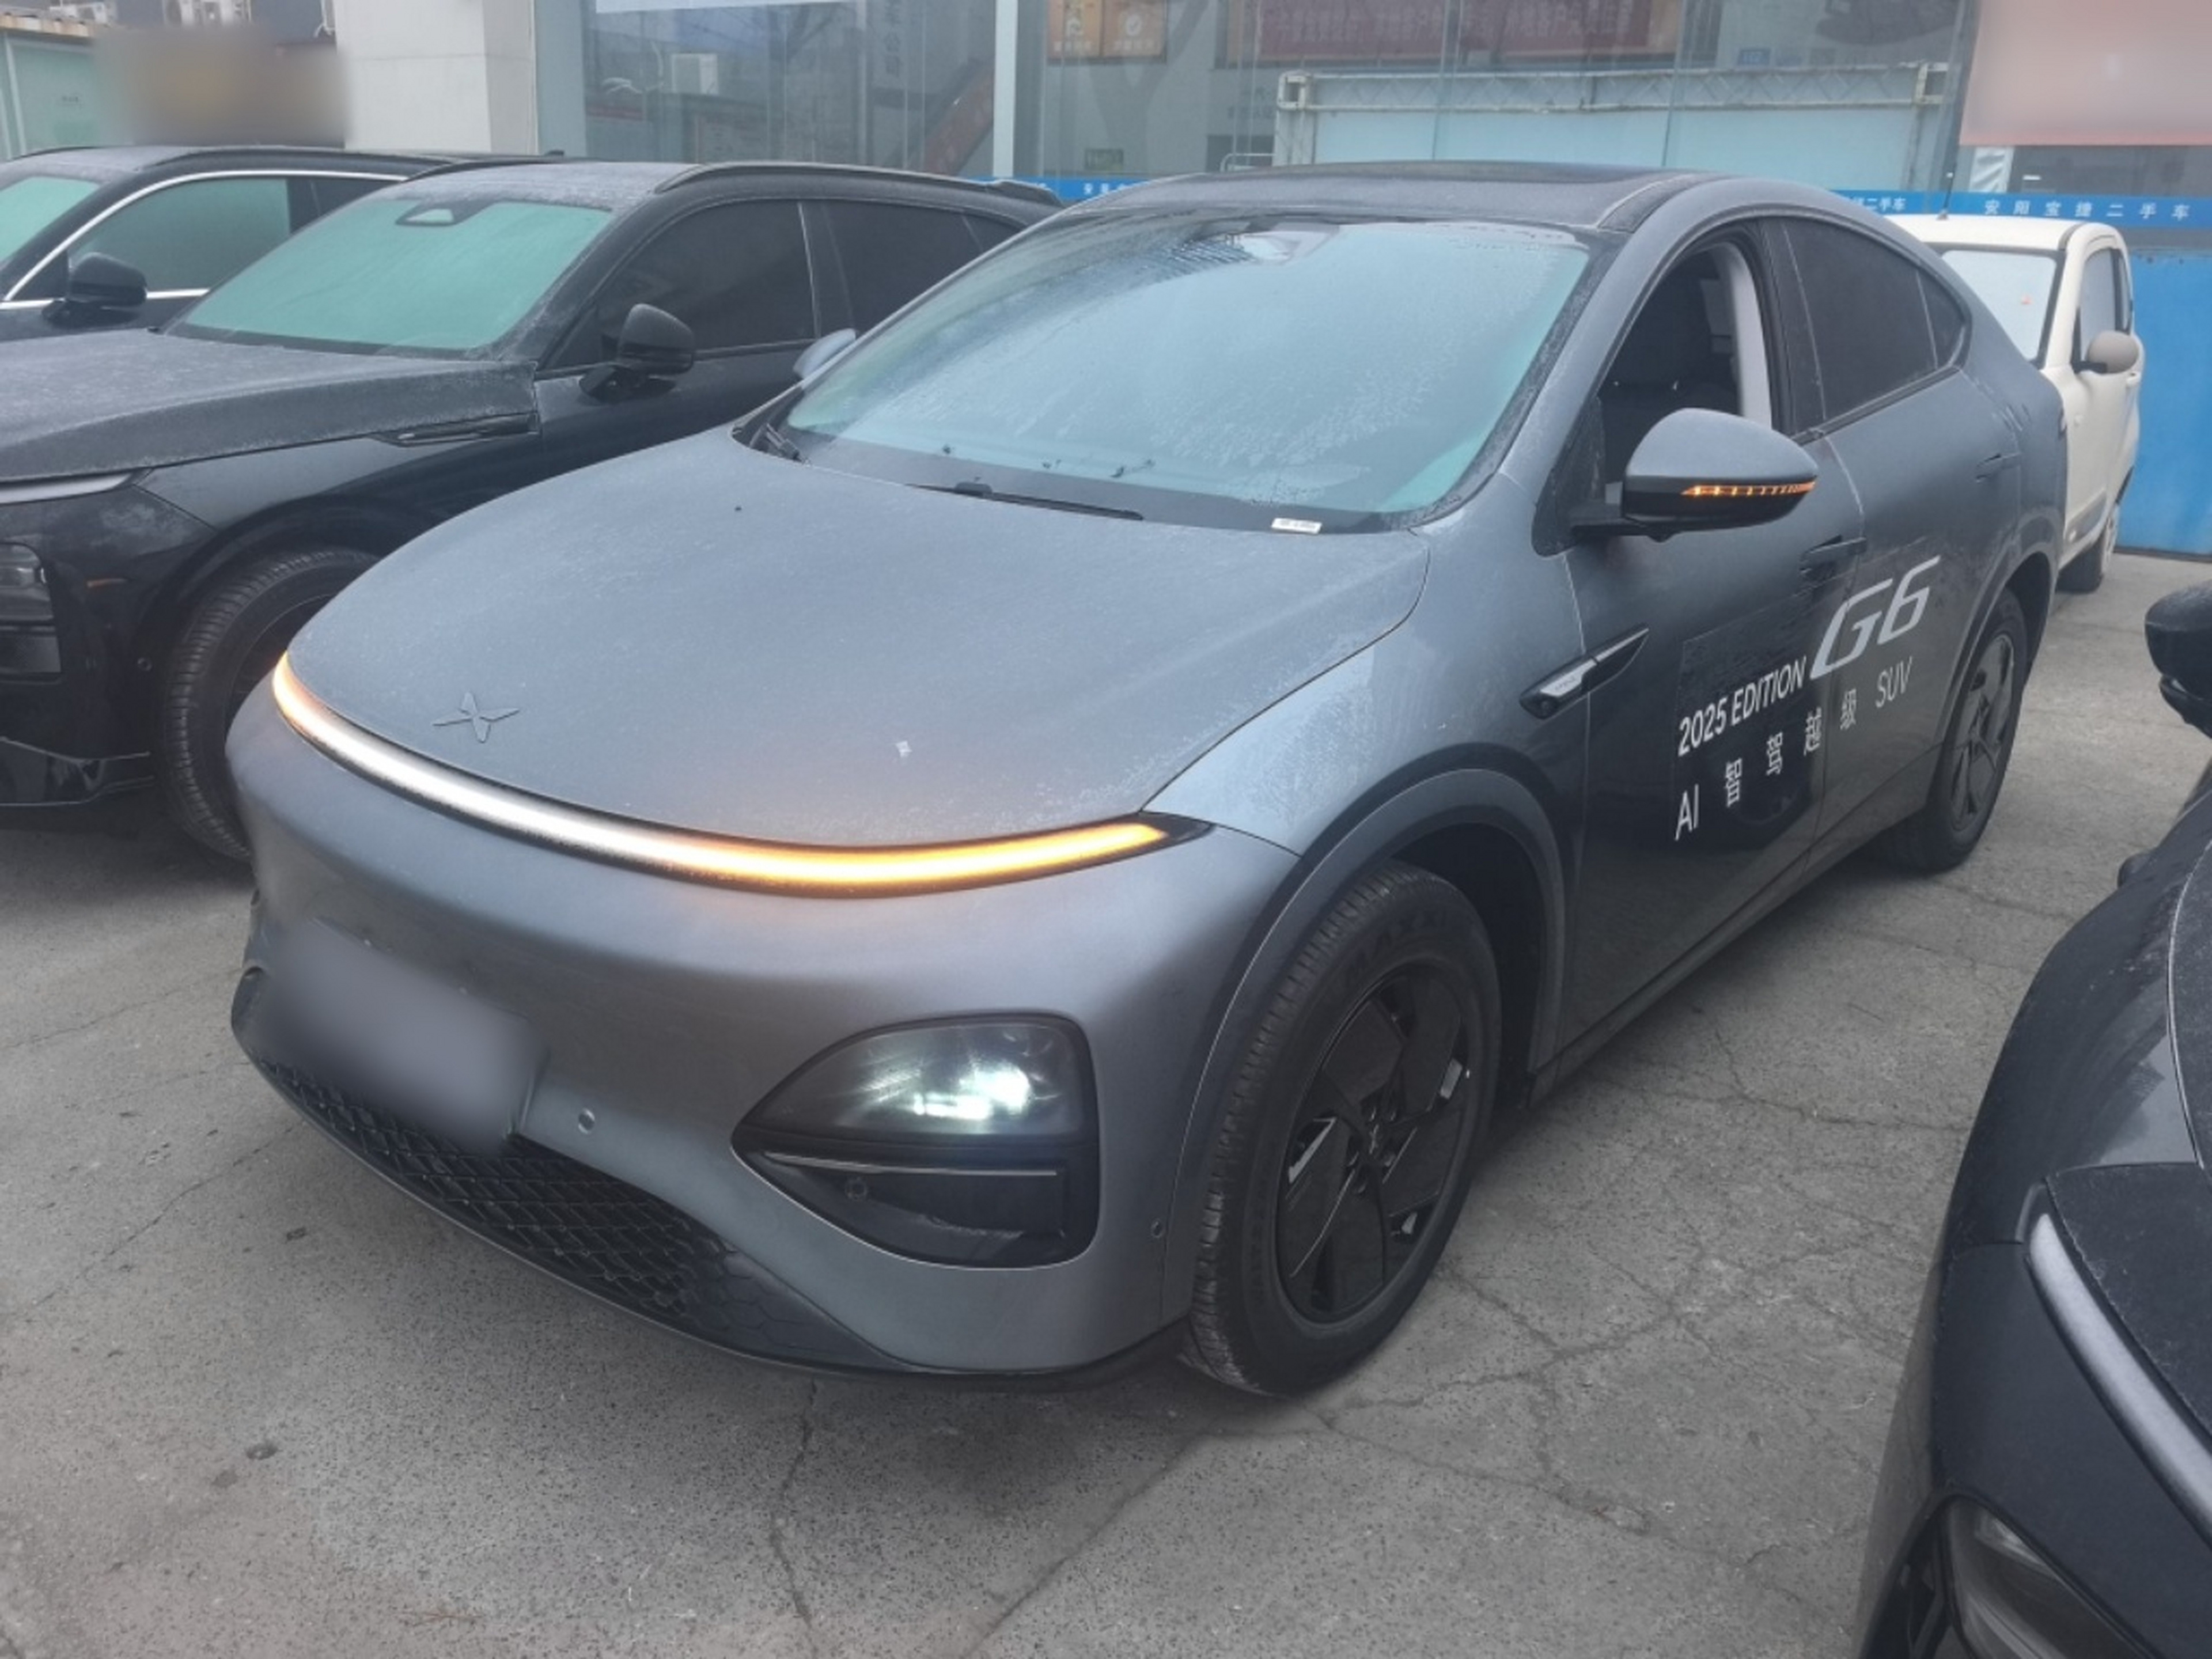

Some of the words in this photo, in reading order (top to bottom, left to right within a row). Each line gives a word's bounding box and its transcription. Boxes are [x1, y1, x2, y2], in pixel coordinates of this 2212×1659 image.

[1675, 783, 1699, 842] AI
[1875, 656, 1913, 709] SUV
[1678, 696, 1728, 757] 2025
[1731, 655, 1806, 726] EDITION
[1809, 554, 1941, 680] G6
